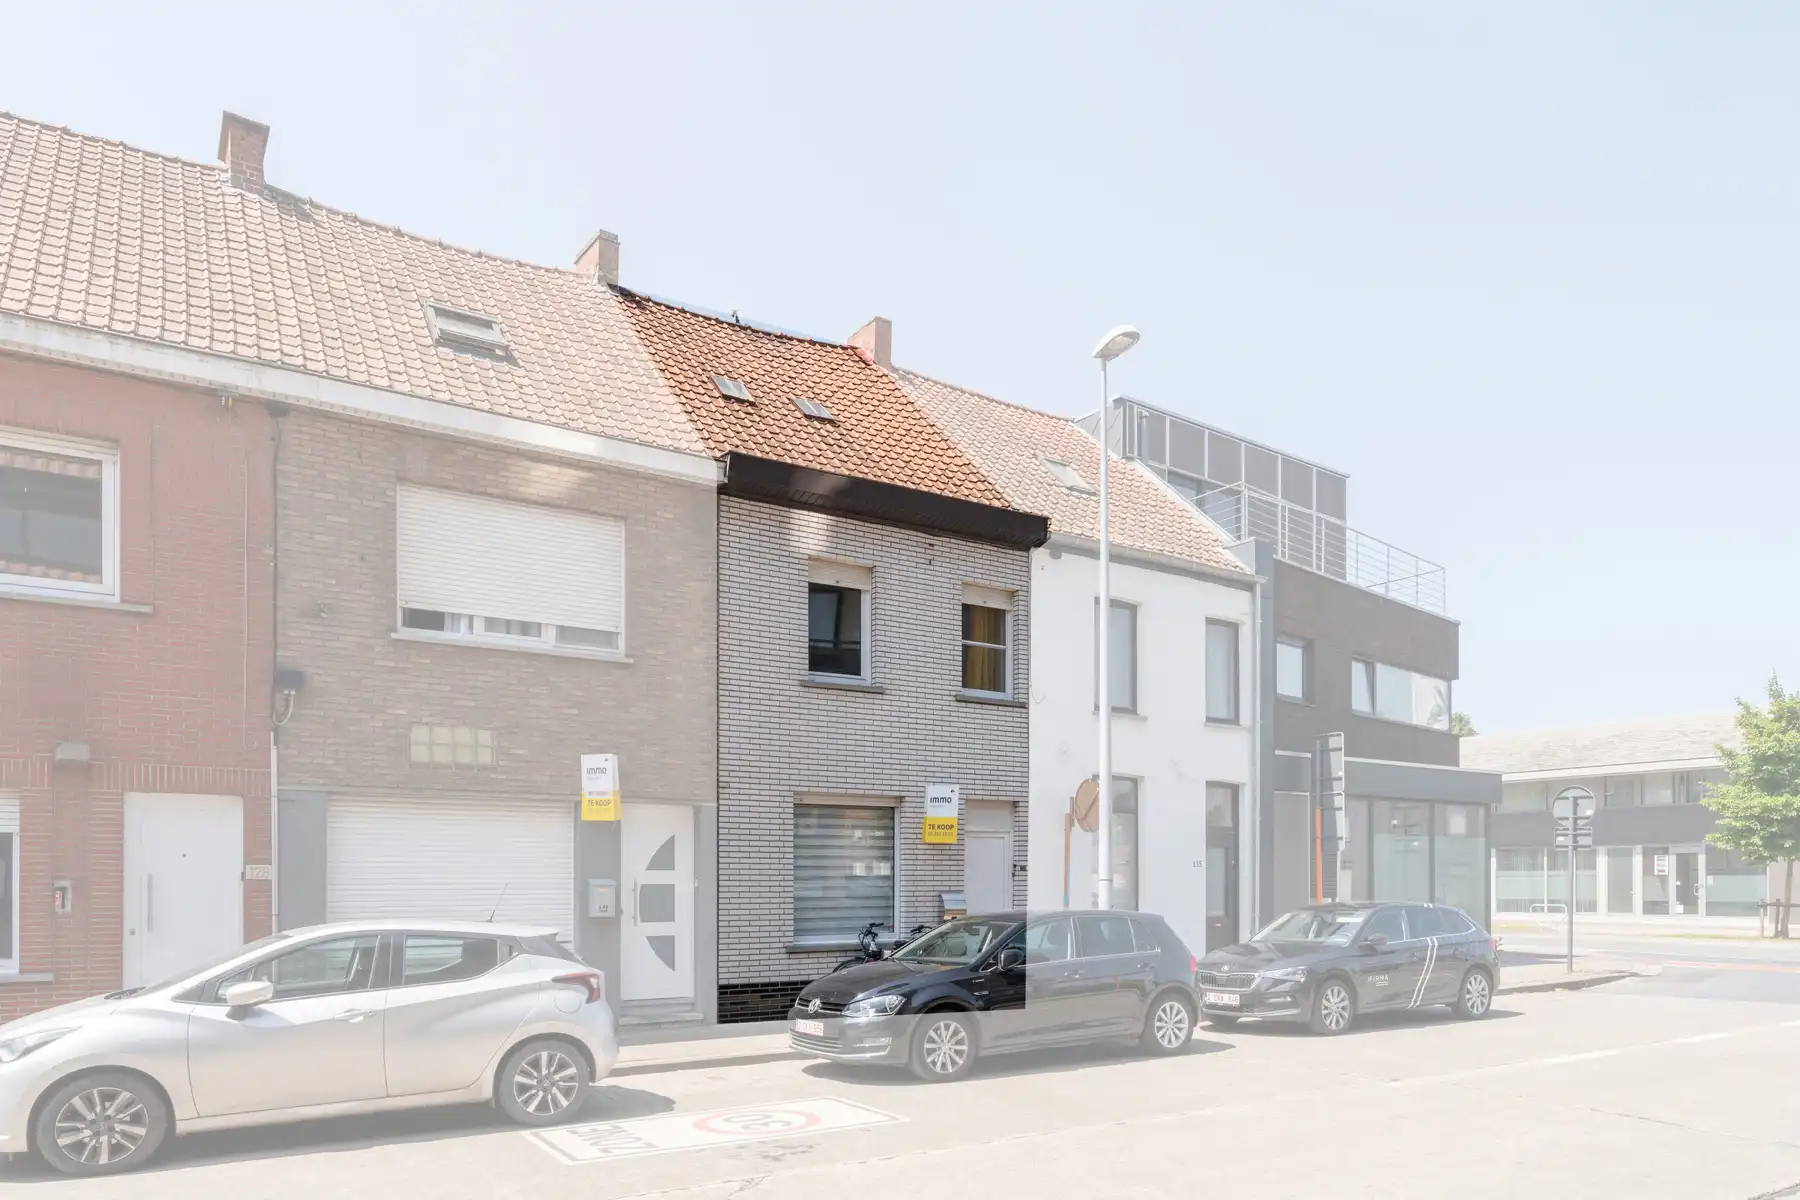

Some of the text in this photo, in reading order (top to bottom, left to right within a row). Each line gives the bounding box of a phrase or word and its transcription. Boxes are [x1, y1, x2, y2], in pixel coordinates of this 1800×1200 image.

[586, 767, 607, 775] immo
[587, 799, 612, 807] TE KOOP
[929, 796, 953, 804] immo
[927, 823, 955, 831] TE KOOP
